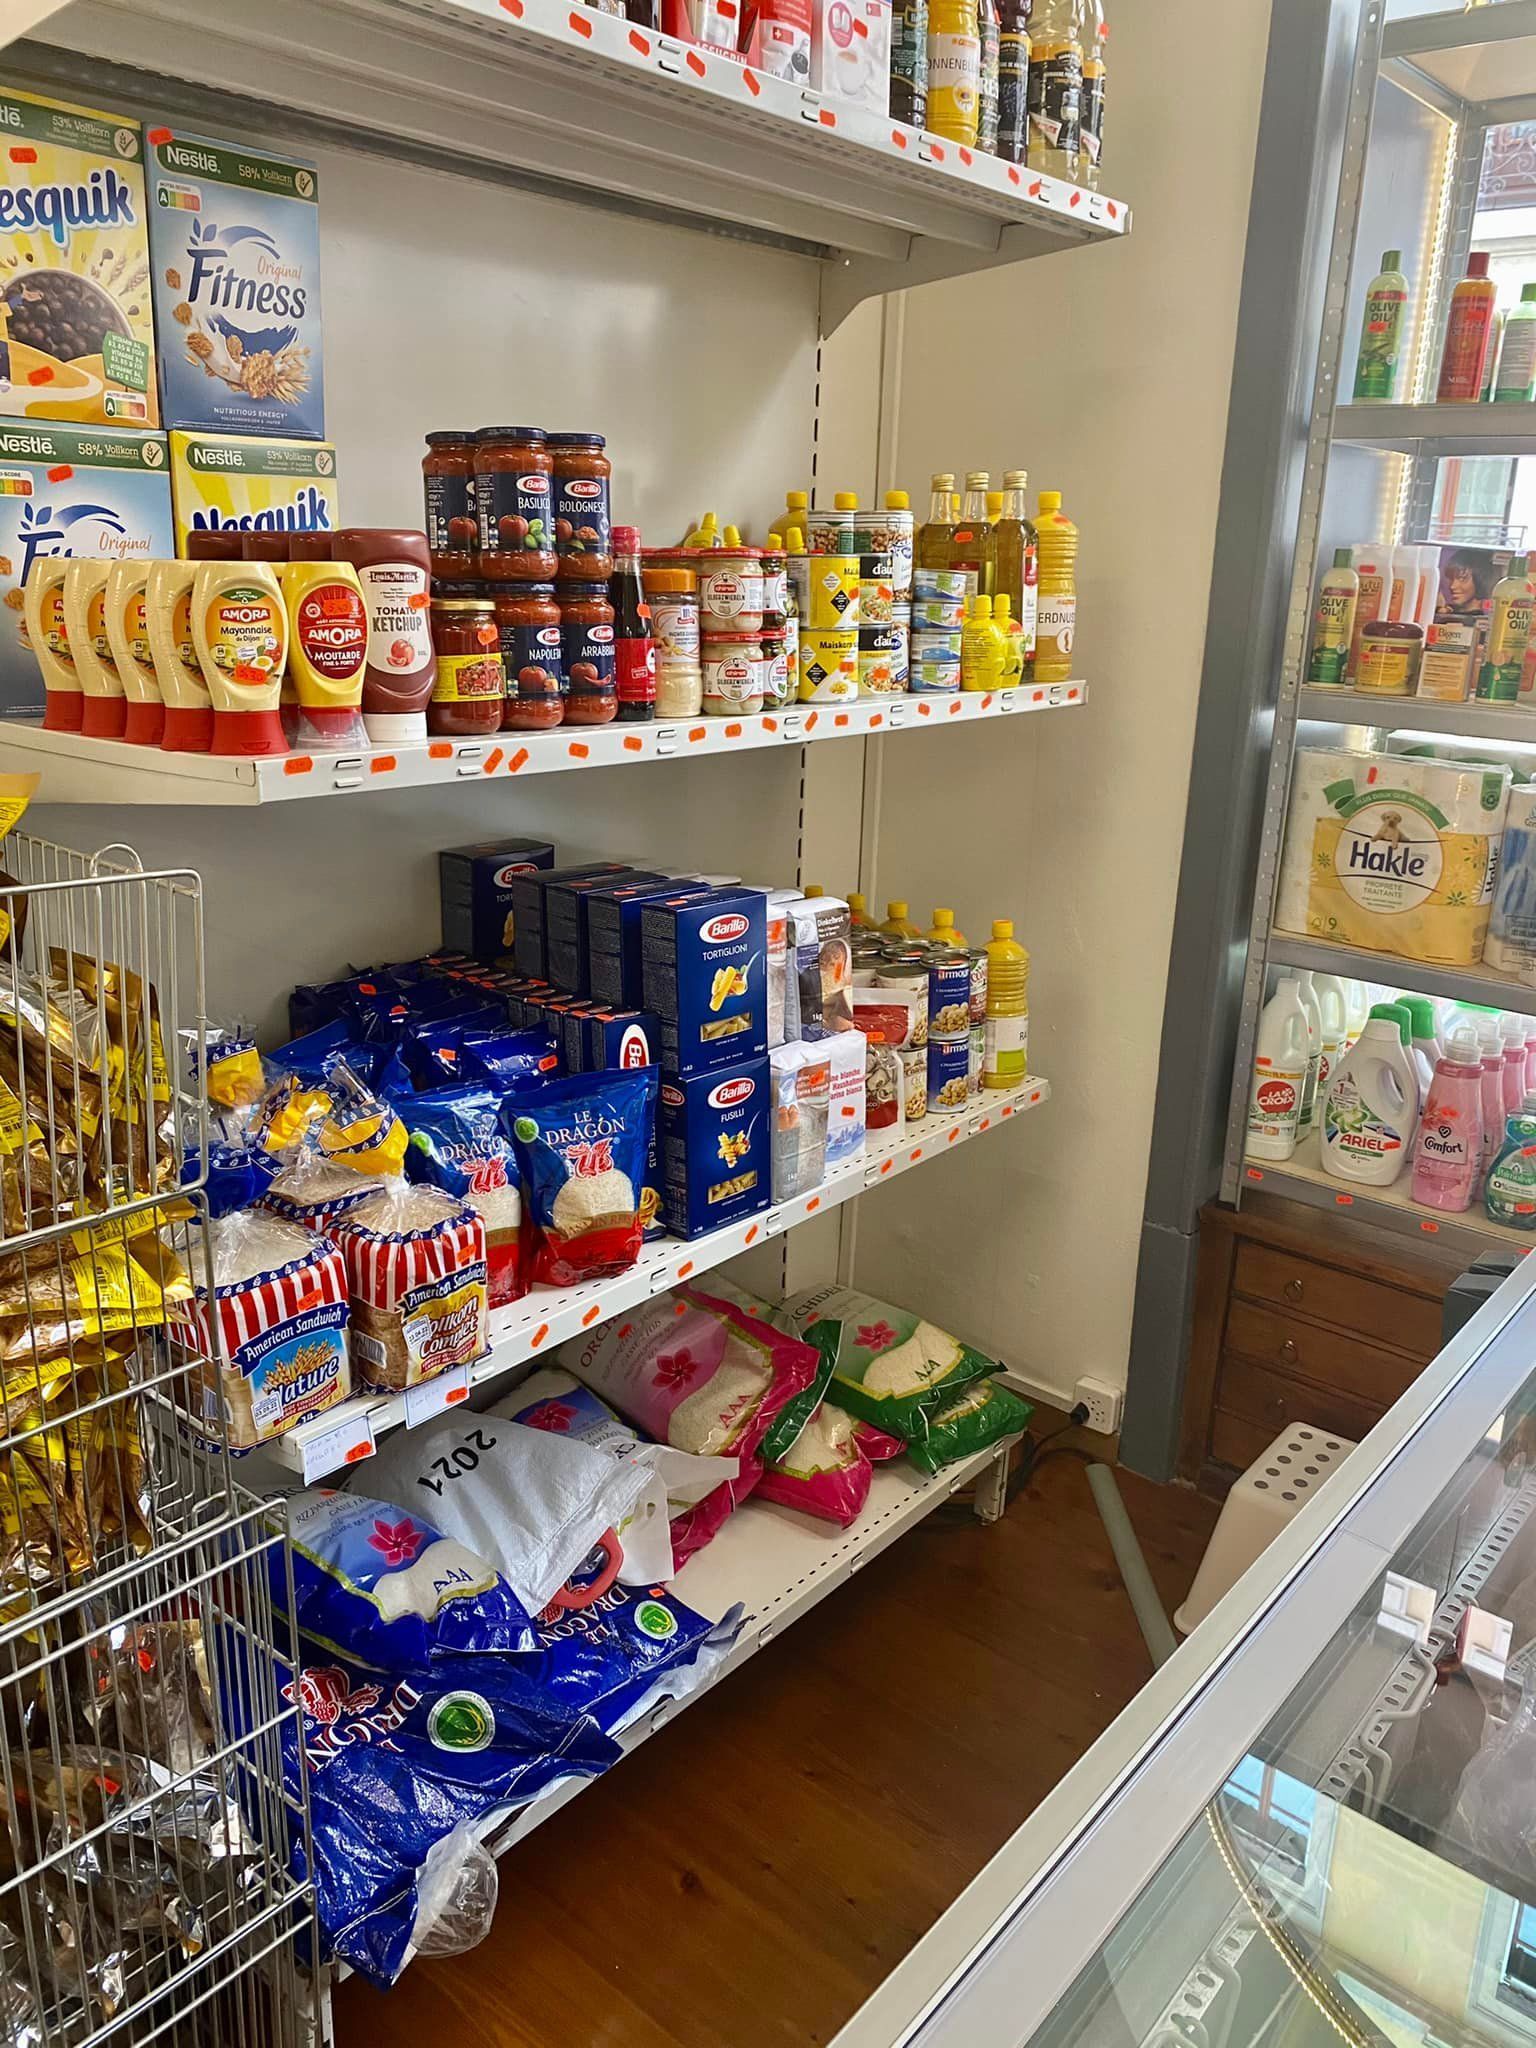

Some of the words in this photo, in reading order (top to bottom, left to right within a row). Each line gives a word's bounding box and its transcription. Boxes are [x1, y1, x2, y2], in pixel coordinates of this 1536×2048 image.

[73, 120, 110, 138] Vollkorn
[166, 146, 221, 174] Nestlé
[238, 164, 260, 180] 58%
[261, 167, 292, 185] Vollkorn
[257, 255, 303, 284] Original
[187, 248, 306, 319] Fitness
[1369, 302, 1401, 312] OLIVE
[213, 407, 257, 417] NUTRITIOUS
[78, 443, 103, 456] 58%
[104, 444, 139, 456] Vollkorn
[194, 447, 246, 467] Nestlé
[559, 501, 607, 513] BOLOGNESE
[99, 531, 152, 558] Original
[376, 606, 417, 616] TOMATO
[1320, 598, 1349, 608] OLIVE
[221, 608, 270, 623] AMORA
[372, 616, 422, 632] KETCHUP
[220, 625, 273, 636] Mayonnaise
[308, 627, 362, 645] AMORA
[1438, 626, 1463, 640] Bigen
[314, 650, 361, 661] MOUTARDE
[1349, 839, 1425, 877] Hakle
[1485, 846, 1500, 893] Hakle
[711, 919, 746, 937] Barilla
[1327, 917, 1338, 930] 9
[702, 943, 748, 961] TORTIGLIONI
[719, 1081, 752, 1102] Barilla
[1268, 1090, 1281, 1098] LA
[1258, 1096, 1295, 1106] CROIX
[574, 1110, 592, 1124] LE
[720, 1107, 745, 1123] FUSILLI
[544, 1116, 626, 1146] DRAGON
[440, 1135, 506, 1161] DRAGO
[1340, 1133, 1385, 1151] ARIEL
[1424, 1136, 1464, 1155] Comfort
[409, 1281, 452, 1307] American
[453, 1264, 486, 1289] Sandwich
[430, 1297, 478, 1336] ollkorn
[244, 1326, 294, 1362] American
[295, 1306, 342, 1334] Sandwich
[419, 1315, 479, 1359] Complet
[719, 1394, 752, 1429] AAA
[417, 1428, 497, 1496] 2021
[433, 1567, 475, 1595] AAA
[537, 1584, 632, 1648] DRAGON
[585, 1622, 612, 1646] LE
